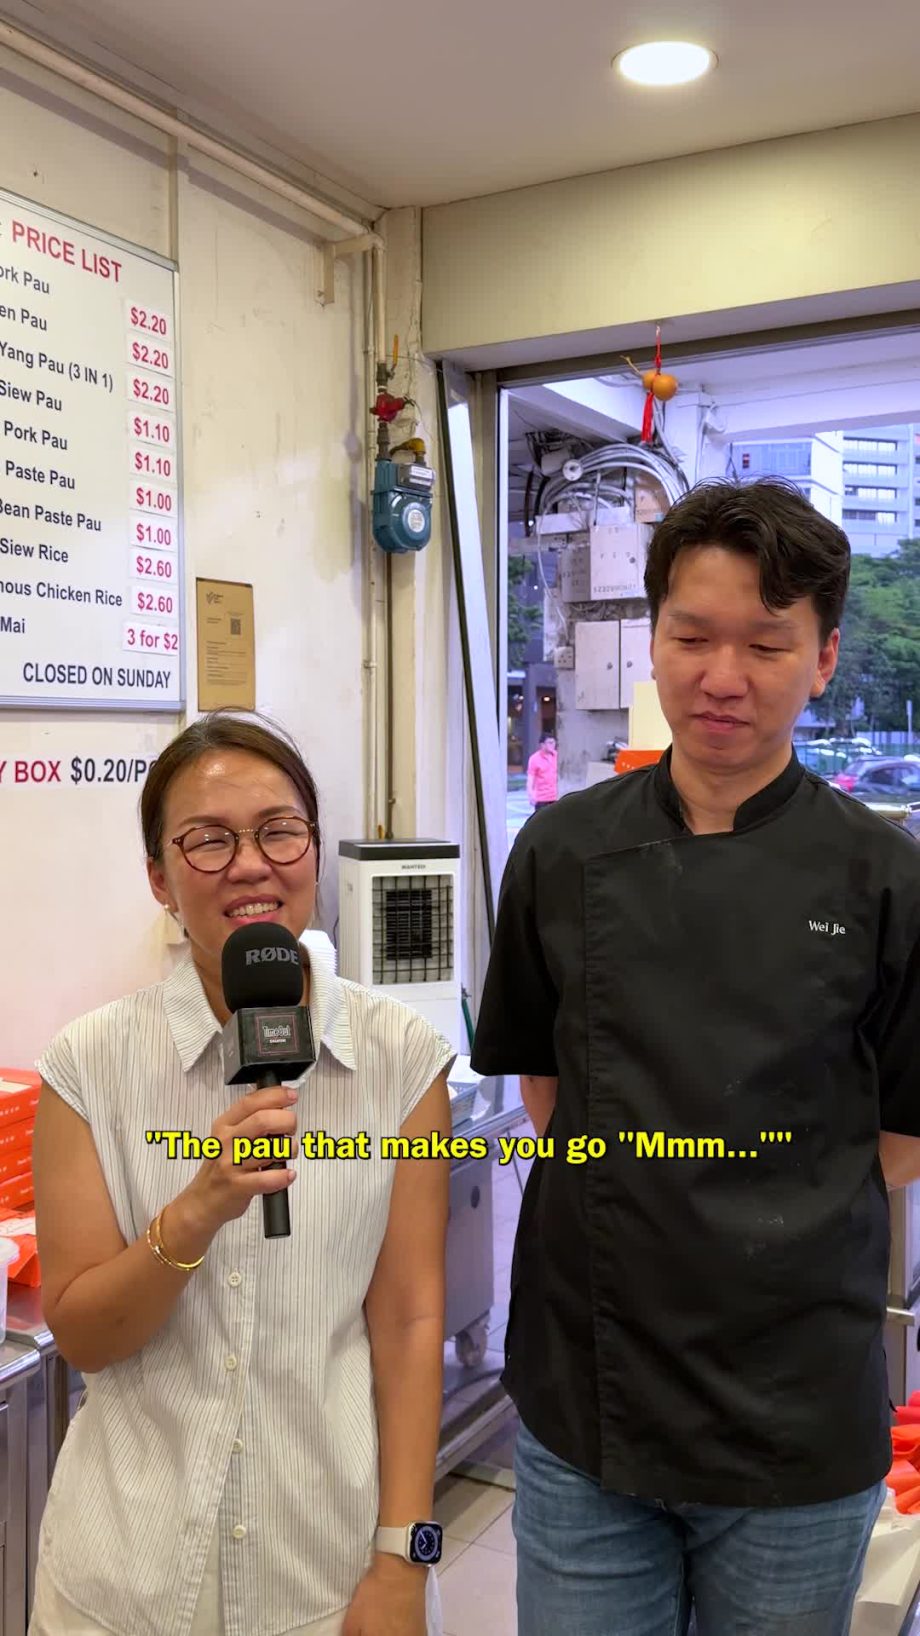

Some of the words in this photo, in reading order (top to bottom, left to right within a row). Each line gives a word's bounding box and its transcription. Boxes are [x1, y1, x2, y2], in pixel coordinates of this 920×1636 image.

[12, 220, 75, 266] PRICE
[81, 248, 122, 282] LIST
[23, 271, 50, 295] Pau
[20, 308, 48, 331] Pau
[130, 306, 167, 336] $2.20
[0, 341, 34, 369] Yang
[38, 352, 64, 375] Pau
[68, 361, 81, 381] (3
[84, 366, 97, 386] IN
[102, 372, 113, 393] 1)
[132, 341, 169, 370] $2.20
[0, 379, 32, 403] Siew
[36, 389, 63, 411] Pau
[133, 378, 169, 405] $2.20
[4, 420, 37, 443] Pork
[41, 429, 68, 451] Pau
[133, 416, 170, 443] $1.10
[5, 459, 46, 483] Paste
[50, 470, 75, 490] Pau
[134, 451, 171, 477] $1.10
[136, 487, 172, 512] $1.00
[35, 504, 73, 527] Paste
[77, 513, 102, 532] Pau
[136, 523, 171, 546] $1.00
[0, 538, 34, 557] Siew
[38, 544, 69, 563] Rice
[136, 555, 172, 579] $2.60
[36, 581, 91, 604] Chicken
[95, 590, 123, 607] Rice
[137, 592, 173, 614] $2.60
[0, 616, 26, 634] Mai
[127, 628, 136, 646] 3
[140, 629, 159, 648] for
[23, 662, 87, 684] CLOSED
[92, 666, 113, 686] ON
[117, 668, 171, 689] SUNDAY
[15, 760, 61, 783] BOX
[808, 920, 829, 932] Wei
[831, 923, 846, 936] Jie
[244, 946, 299, 966] RØDE
